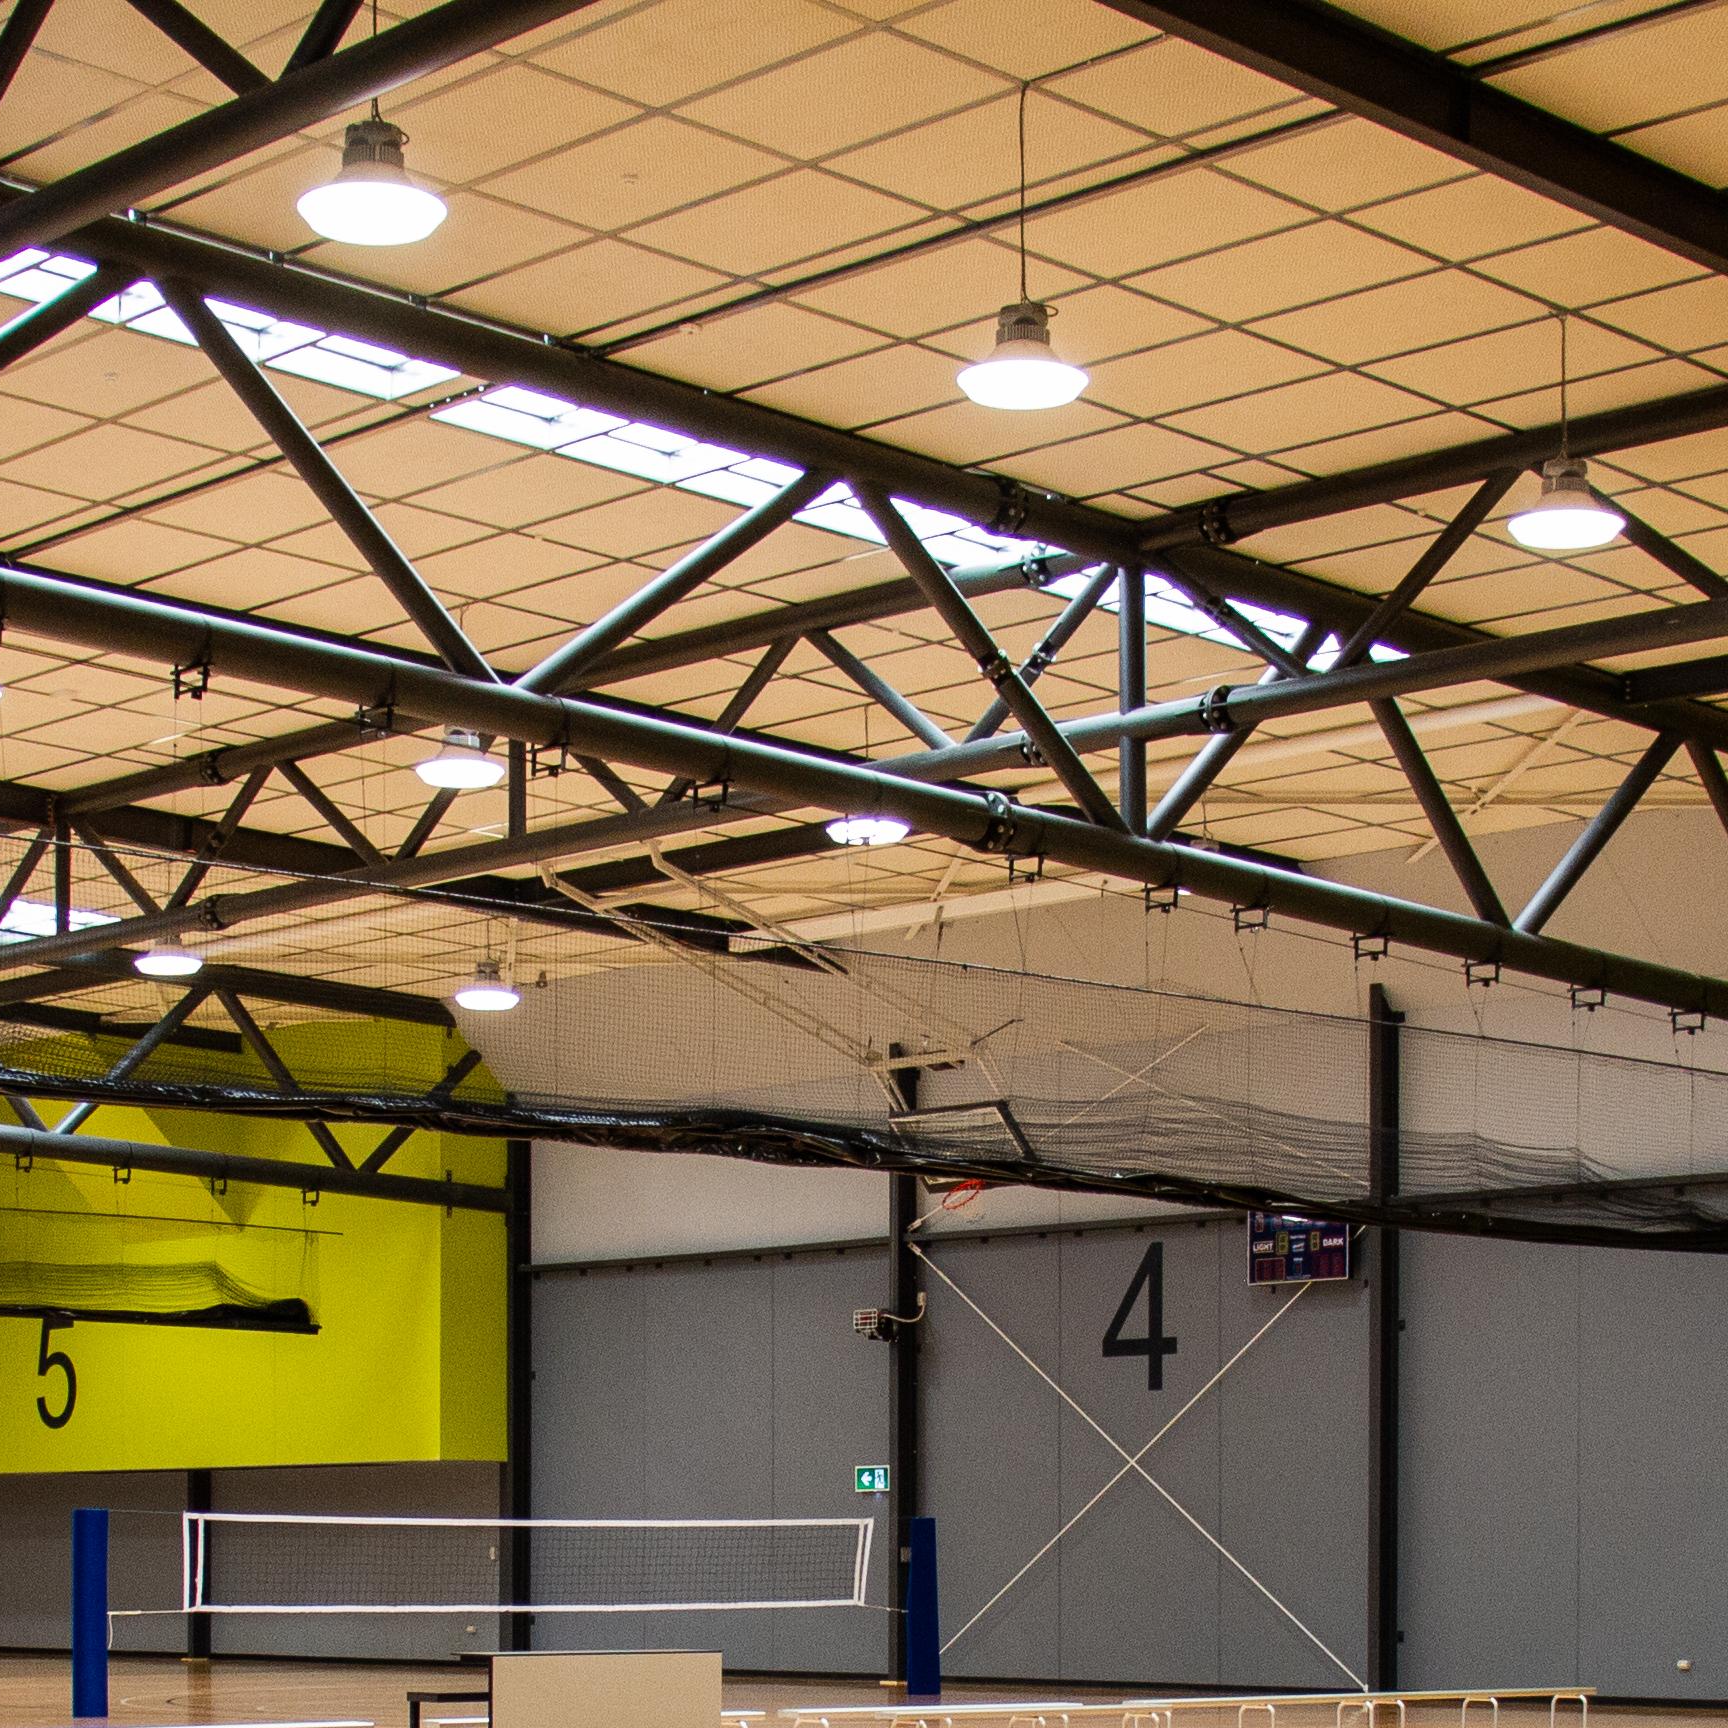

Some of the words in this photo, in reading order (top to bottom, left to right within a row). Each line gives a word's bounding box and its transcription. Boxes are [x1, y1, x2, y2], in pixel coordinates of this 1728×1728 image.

[1253, 1243, 1273, 1253] LIGHT
[1322, 1237, 1344, 1248] DARK
[36, 1315, 77, 1430] 5
[1101, 1241, 1178, 1391] 4
